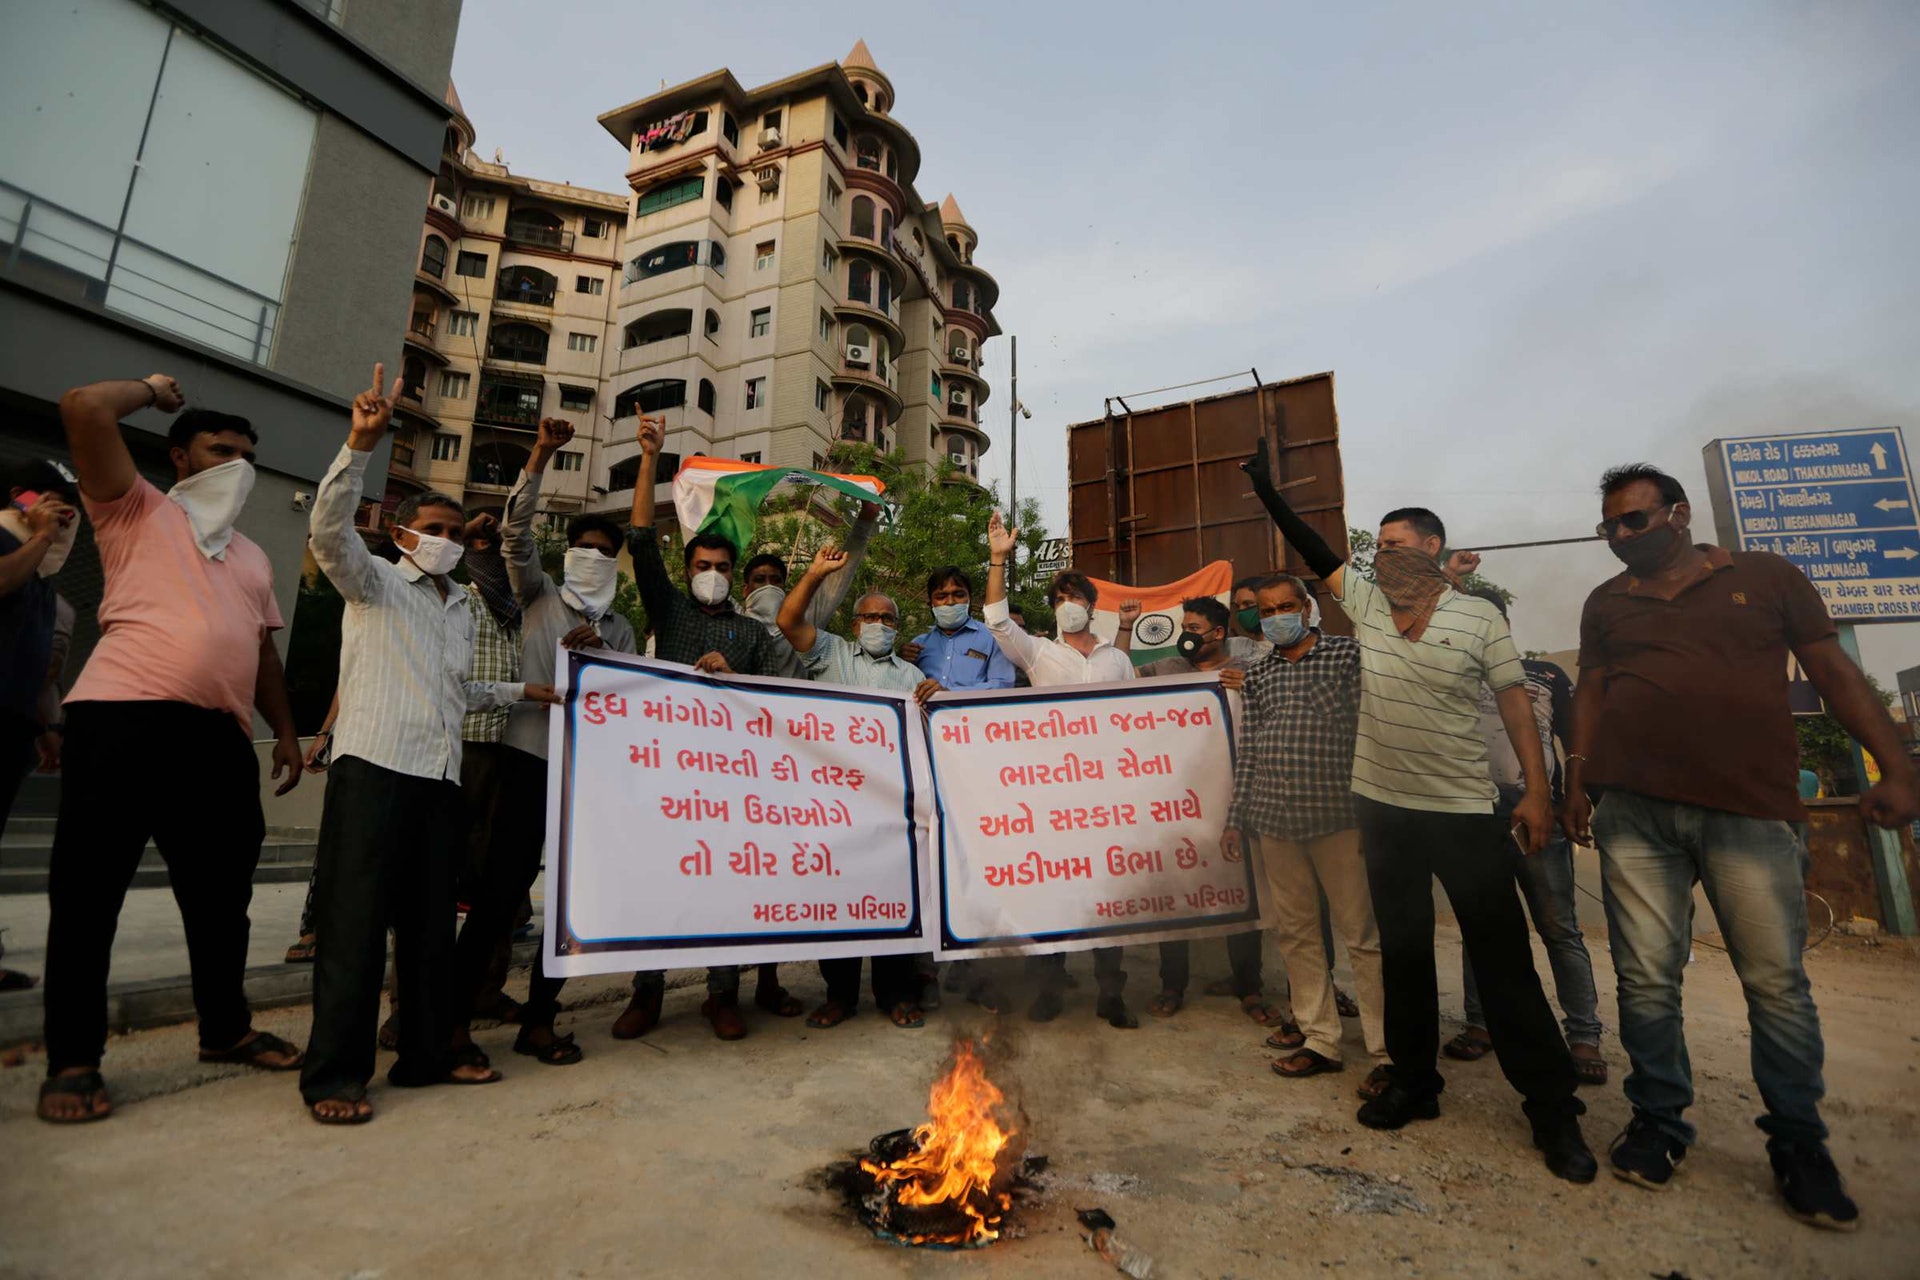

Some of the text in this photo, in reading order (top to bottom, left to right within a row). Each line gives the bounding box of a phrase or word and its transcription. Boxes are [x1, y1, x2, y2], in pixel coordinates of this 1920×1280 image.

[1764, 442, 1781, 460] રોડ
[1735, 469, 1762, 484] NIKOL
[1763, 468, 1788, 482] ROAD
[1794, 463, 1872, 480] THAKKARNAGAR
[1744, 516, 1778, 531] MEMCO
[1783, 513, 1858, 530] MEGHANINAGAR
[1034, 540, 1069, 560] Ak's
[1832, 539, 1877, 559] બાપુનગર
[1811, 562, 1870, 578] BAPUNAGAR
[1836, 581, 1868, 598] ચેમ્બર
[1872, 584, 1893, 596] ચાર
[1898, 583, 1920, 596] રસ્ત
[1830, 602, 1876, 616] CHAMBER
[1878, 601, 1909, 614] CROSS
[582, 690, 897, 754] દુધ માંગોગે તો ખીર દેંગે,
[941, 705, 1213, 745] માં ભારતીના જન-જન
[629, 738, 867, 792] માં ભારતી કી તરફ
[999, 747, 1173, 789] ભારતીય સેના
[660, 789, 854, 828] આંખ ઉઠાઓગે
[978, 788, 1203, 838] અને સરકાર સાથે
[679, 839, 842, 878] તો ચીર દેંગે.
[984, 836, 1208, 888] અડીખમ ઉભા છે.
[753, 894, 907, 923] મદદગાર પરિવાર
[1096, 884, 1246, 919] મદદગાર પરિવાર
